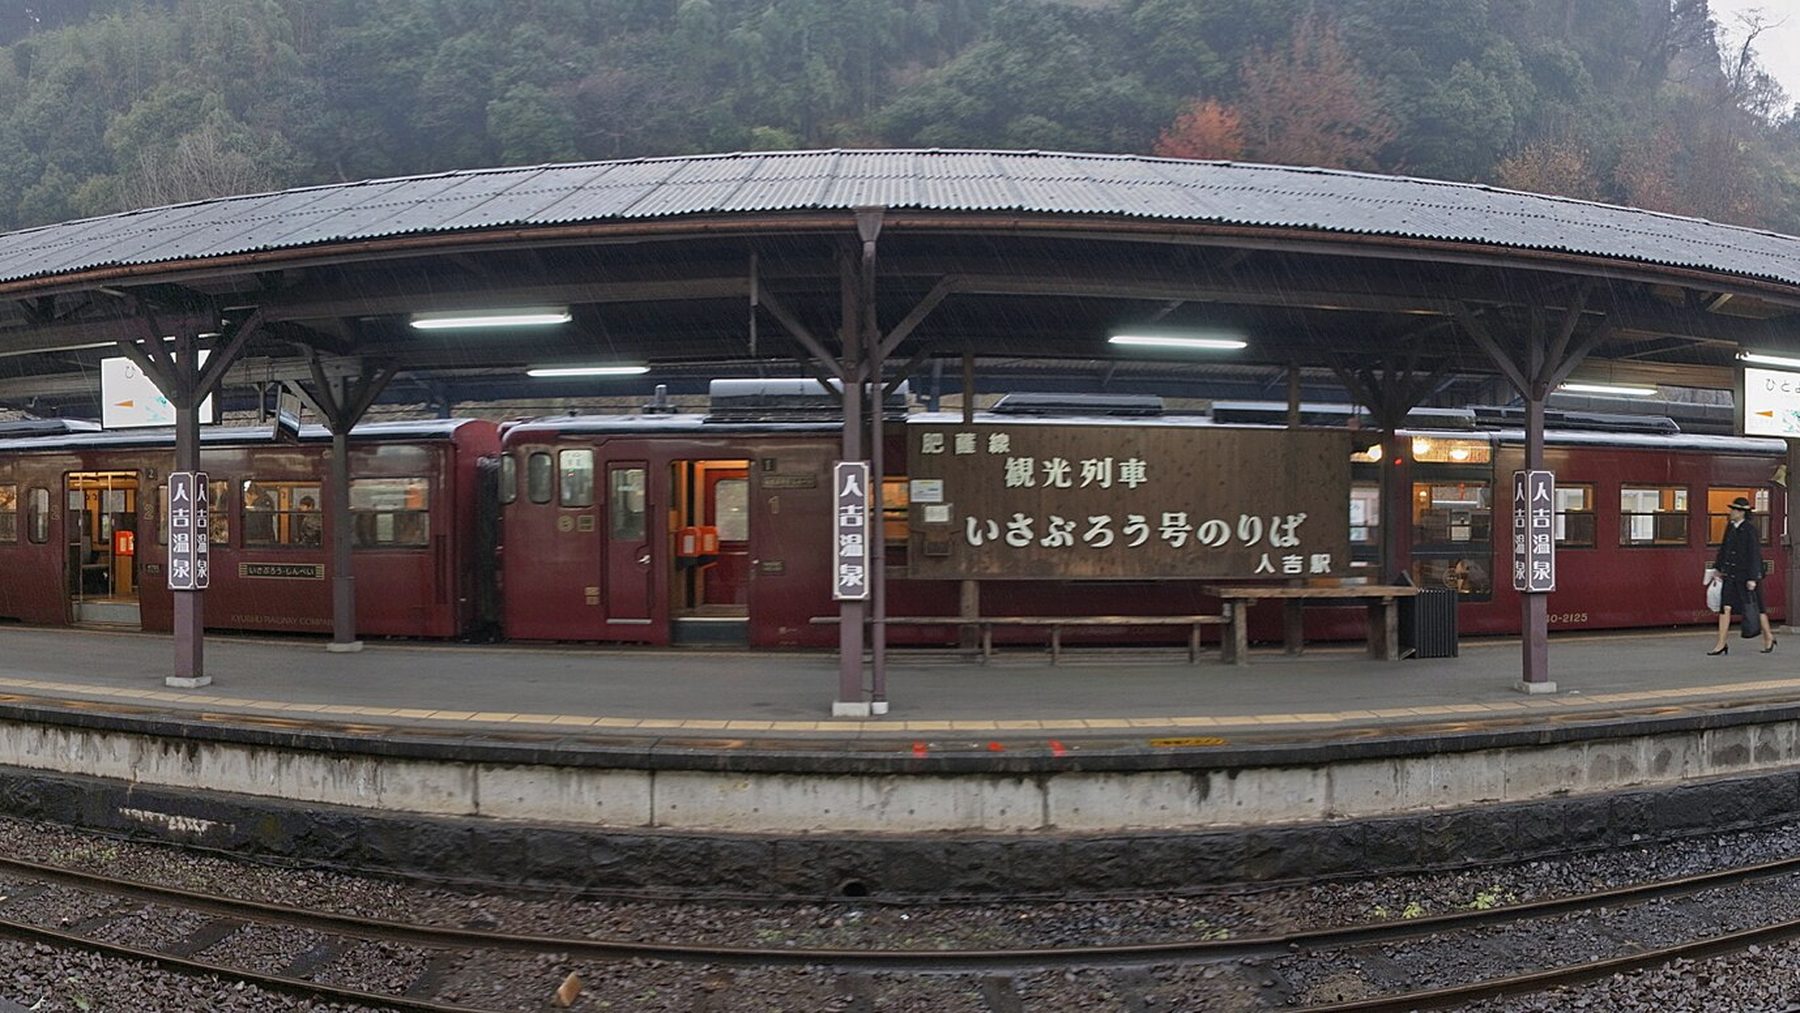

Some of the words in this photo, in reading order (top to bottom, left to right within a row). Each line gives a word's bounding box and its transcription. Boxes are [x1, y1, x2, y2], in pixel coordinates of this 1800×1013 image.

[921, 432, 1011, 454] 肥薩線
[1004, 457, 1148, 489] 観光列車
[173, 482, 190, 578] 人吉温泉
[197, 483, 208, 578] 人吉温泉
[840, 474, 864, 587] 人吉温泉
[965, 511, 1307, 549] いさぶろう号のりば
[1253, 553, 1332, 576] 人吉駅
[1515, 481, 1526, 580] 人吉温泉
[1533, 481, 1551, 580] 人吉温泉
